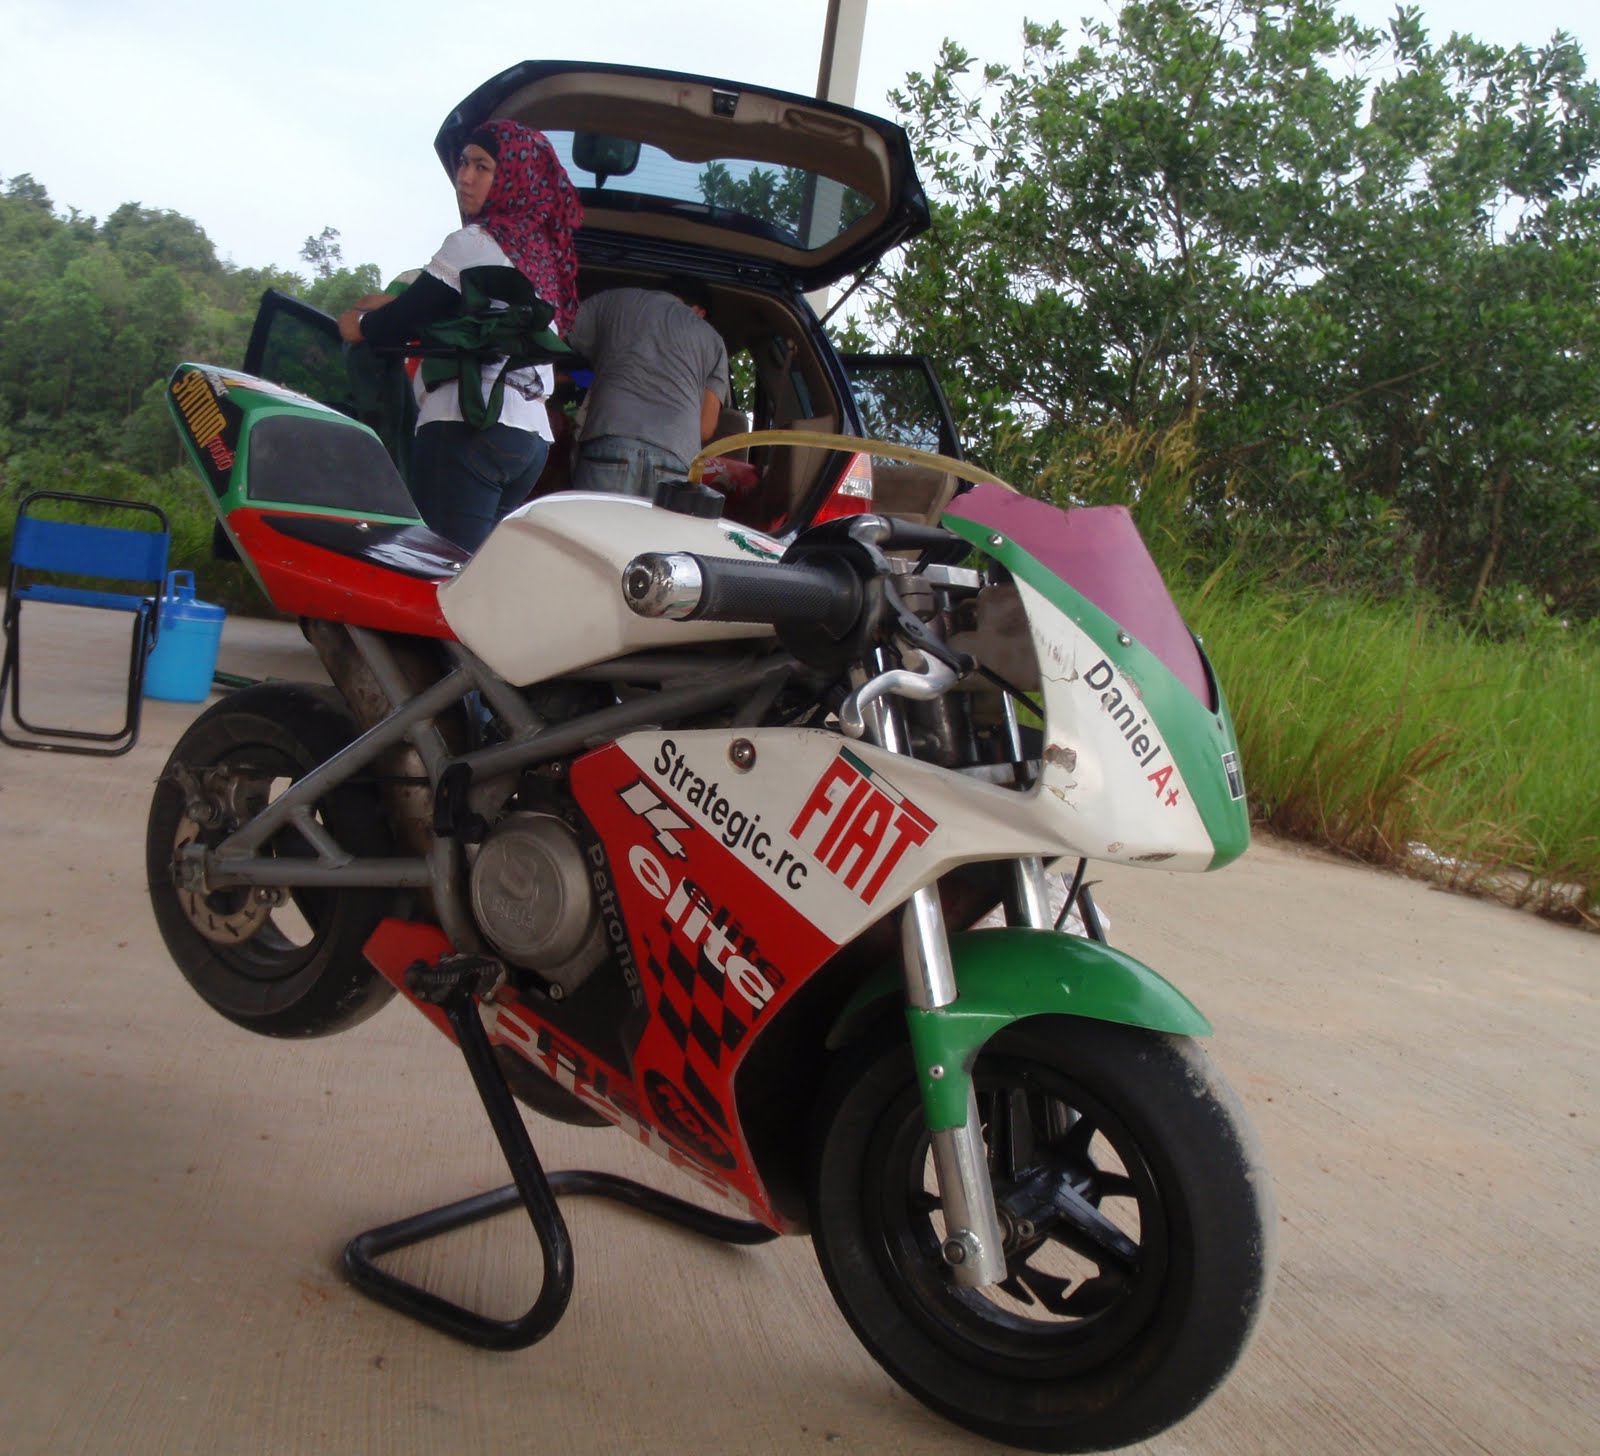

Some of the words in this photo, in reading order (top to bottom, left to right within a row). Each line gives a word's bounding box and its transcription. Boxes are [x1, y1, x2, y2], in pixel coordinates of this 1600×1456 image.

[1083, 659, 1161, 768] Daniel
[1147, 765, 1180, 807] A+
[653, 739, 808, 890] Strategic.rc
[789, 755, 933, 906] FIAT
[628, 844, 776, 1011] elite
